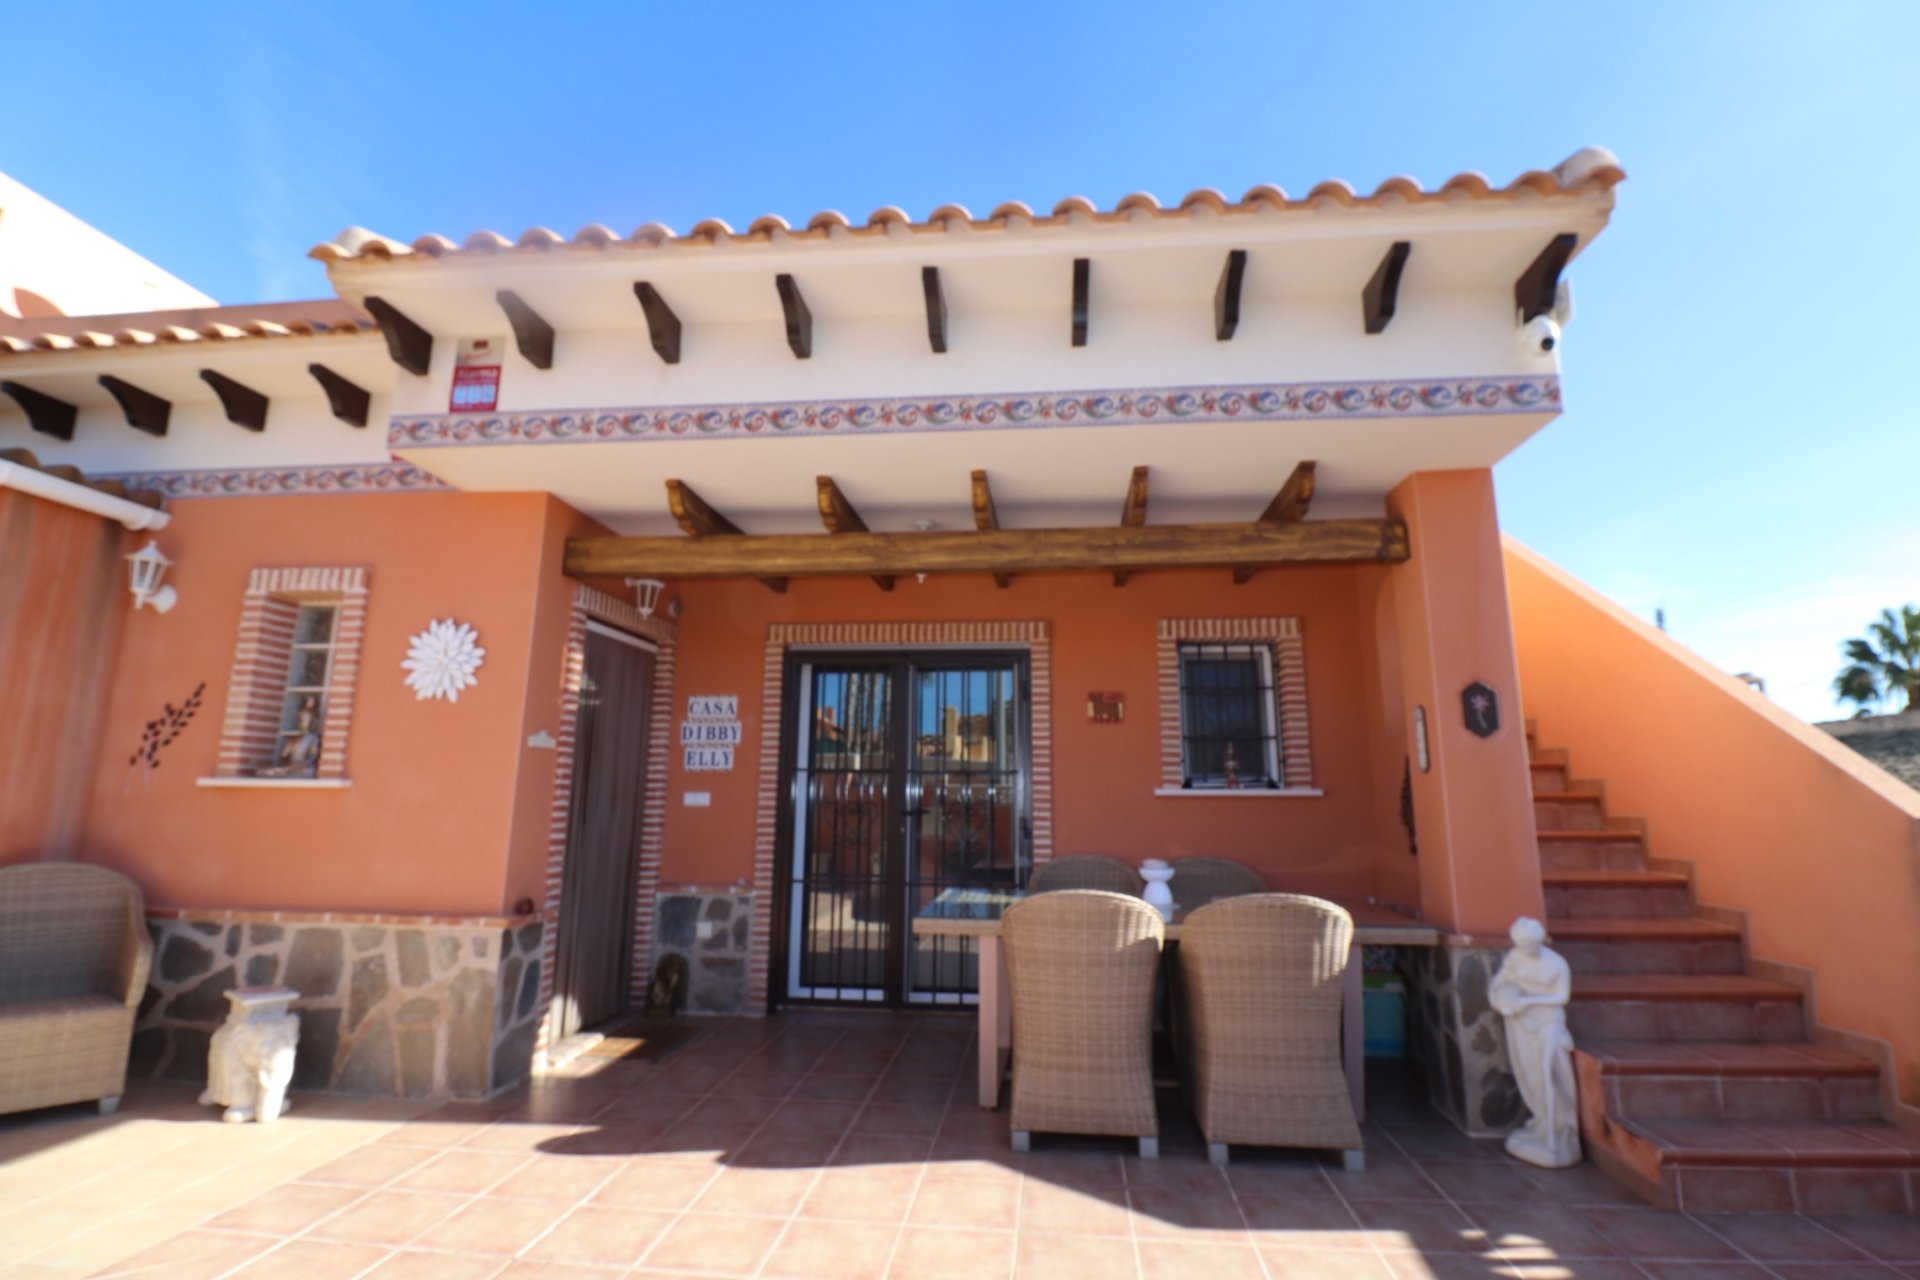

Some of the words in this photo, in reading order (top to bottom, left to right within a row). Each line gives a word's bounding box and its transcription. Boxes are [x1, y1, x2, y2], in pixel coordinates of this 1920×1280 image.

[689, 701, 735, 715] CASA
[682, 725, 739, 740] DIBBY
[687, 751, 731, 766] ELLY
